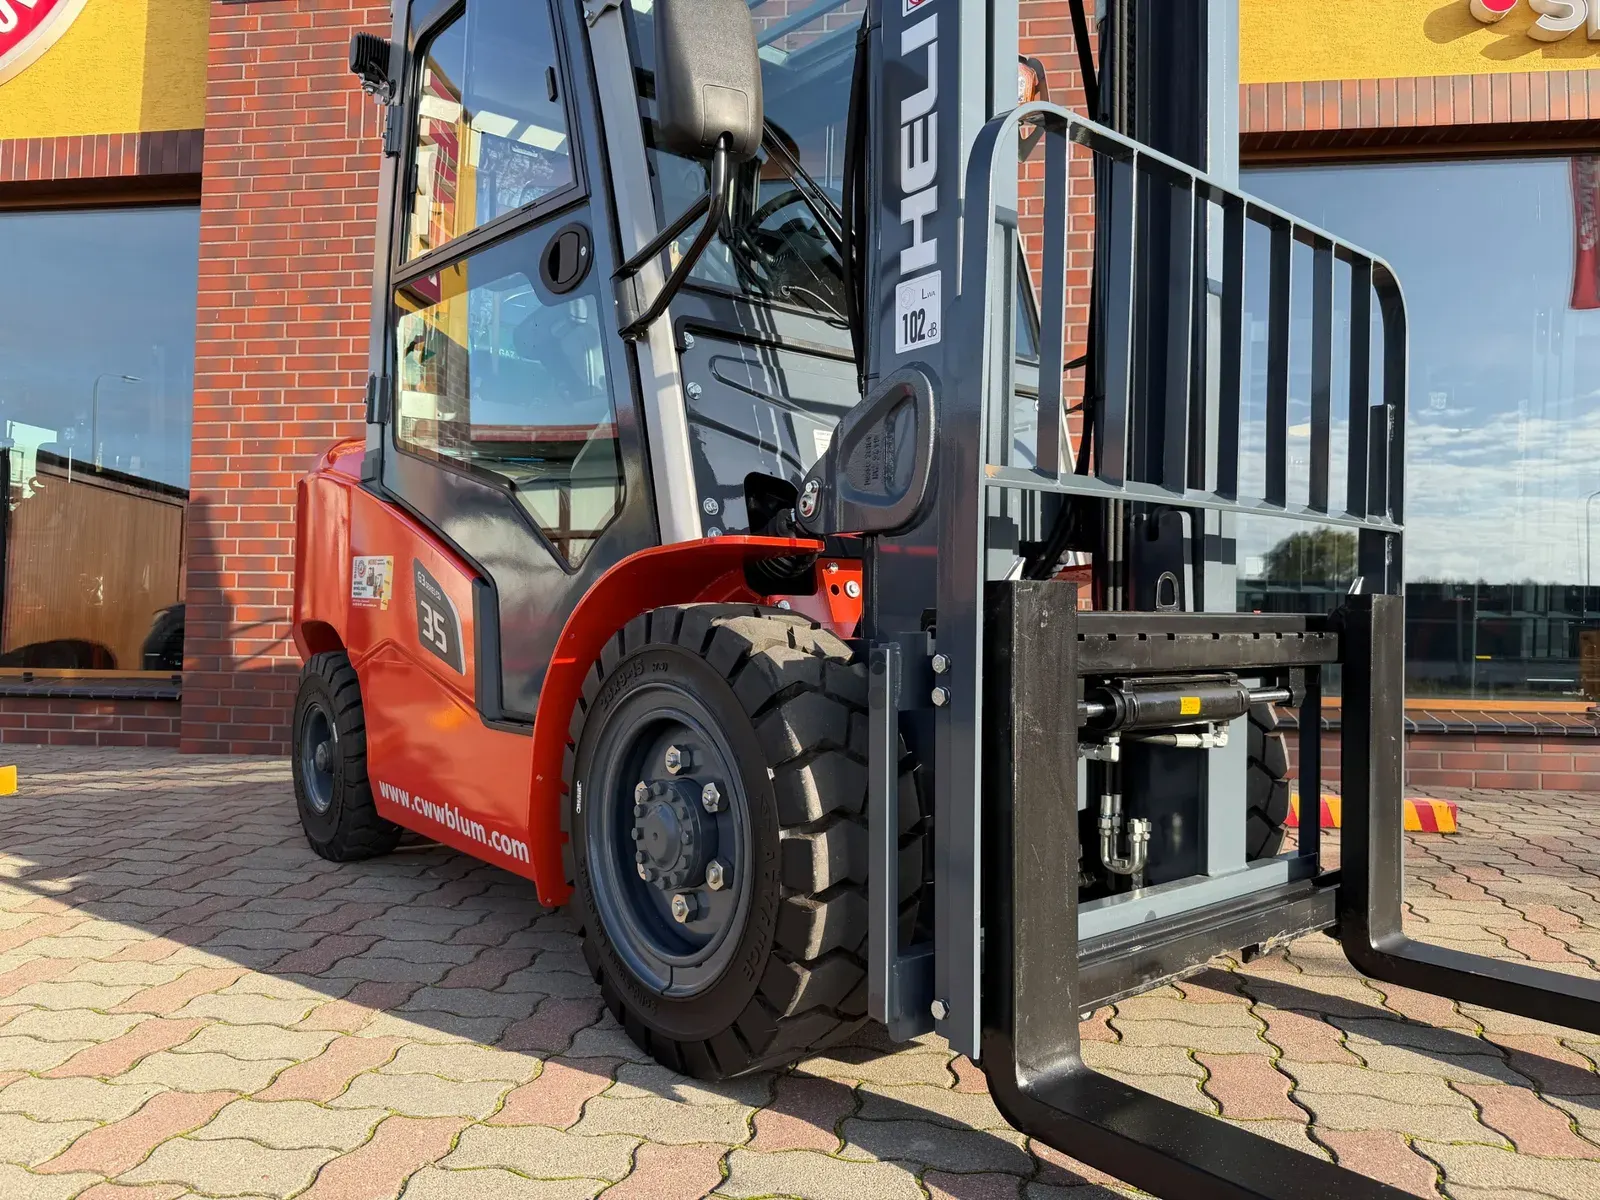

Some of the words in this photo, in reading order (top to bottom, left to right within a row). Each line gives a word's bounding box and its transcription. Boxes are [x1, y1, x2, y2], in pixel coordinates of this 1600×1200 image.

[900, 13, 938, 276] HELI
[902, 308, 926, 345] 102
[927, 321, 938, 338] dB
[420, 600, 447, 654] 35
[379, 780, 530, 864] www.cwwblum.com
